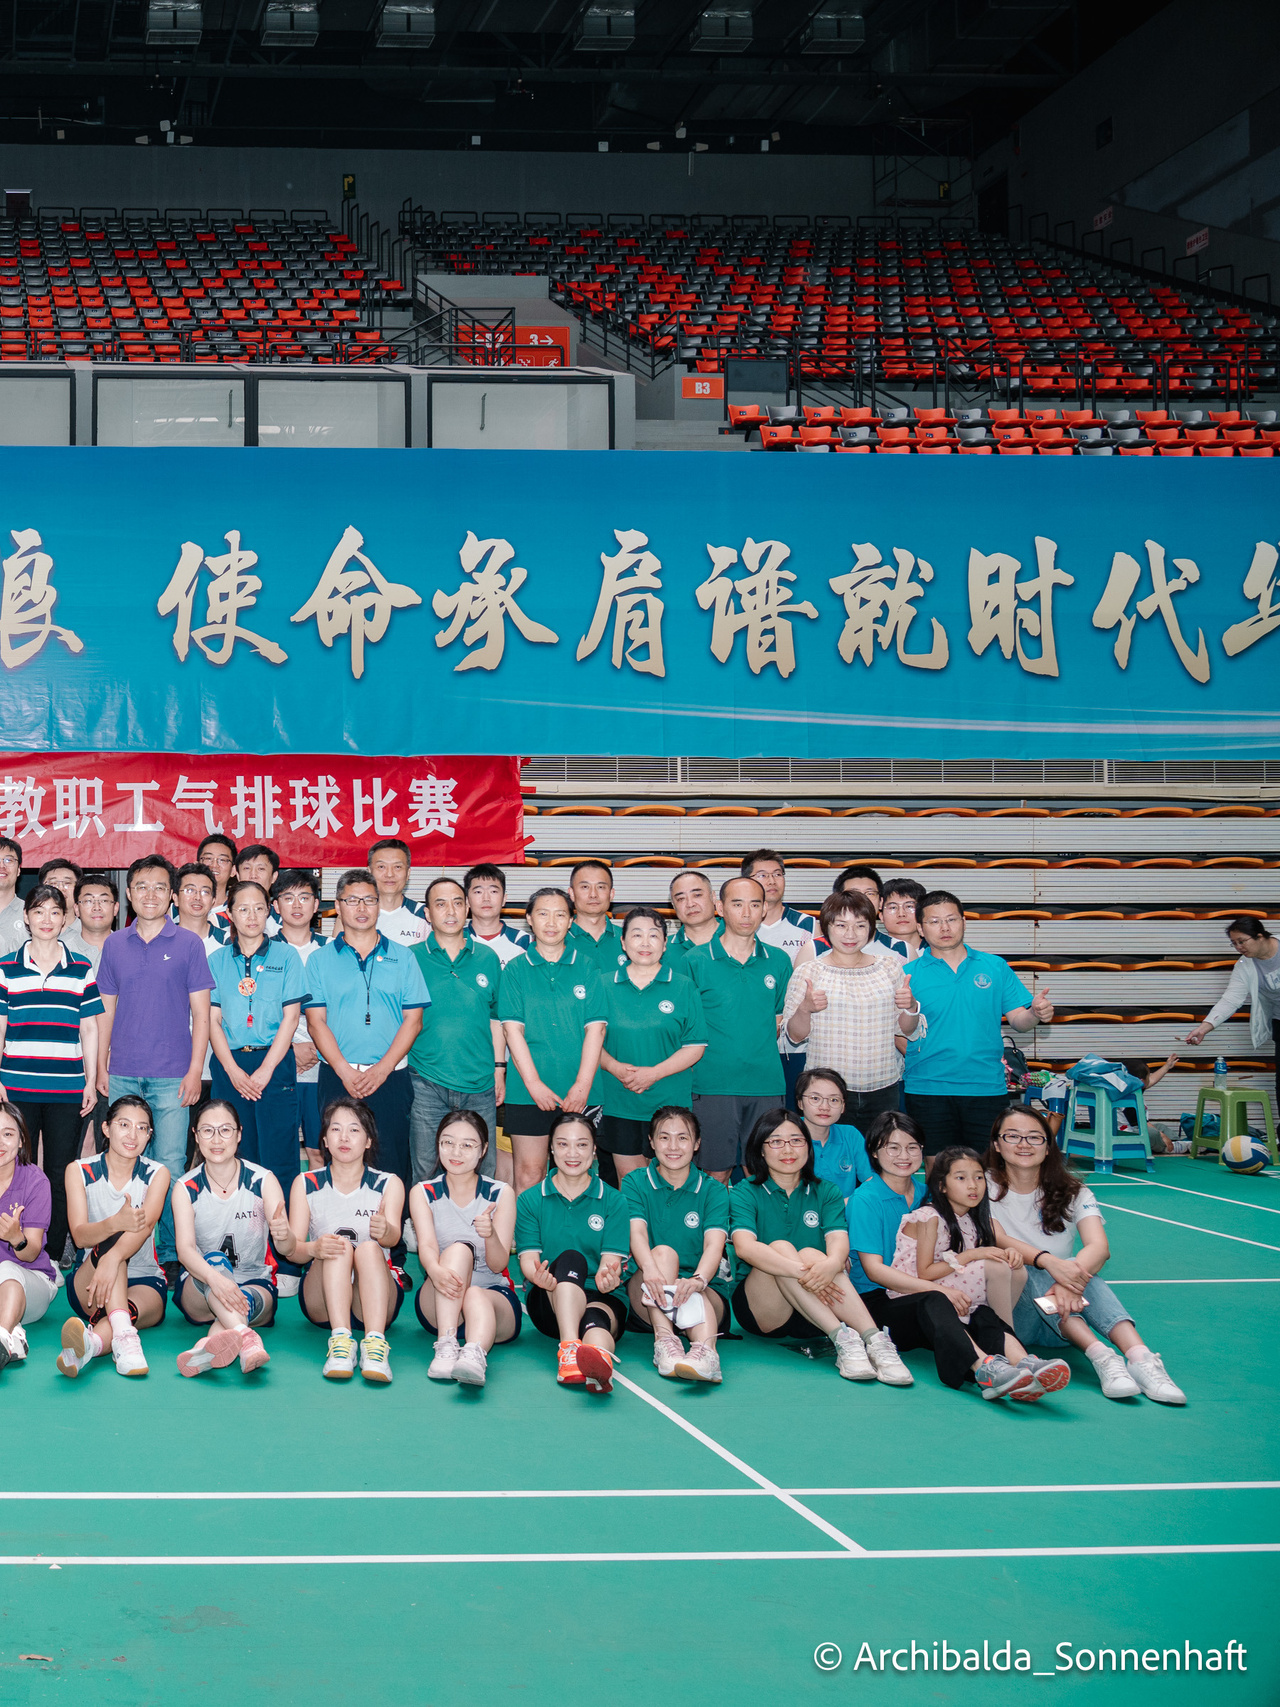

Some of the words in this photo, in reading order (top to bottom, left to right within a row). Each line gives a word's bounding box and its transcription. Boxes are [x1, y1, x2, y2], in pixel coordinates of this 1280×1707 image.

[695, 382, 710, 395] B3
[400, 930, 421, 939] AATU
[354, 1209, 379, 1217] AAT
[218, 1233, 241, 1268] 4
